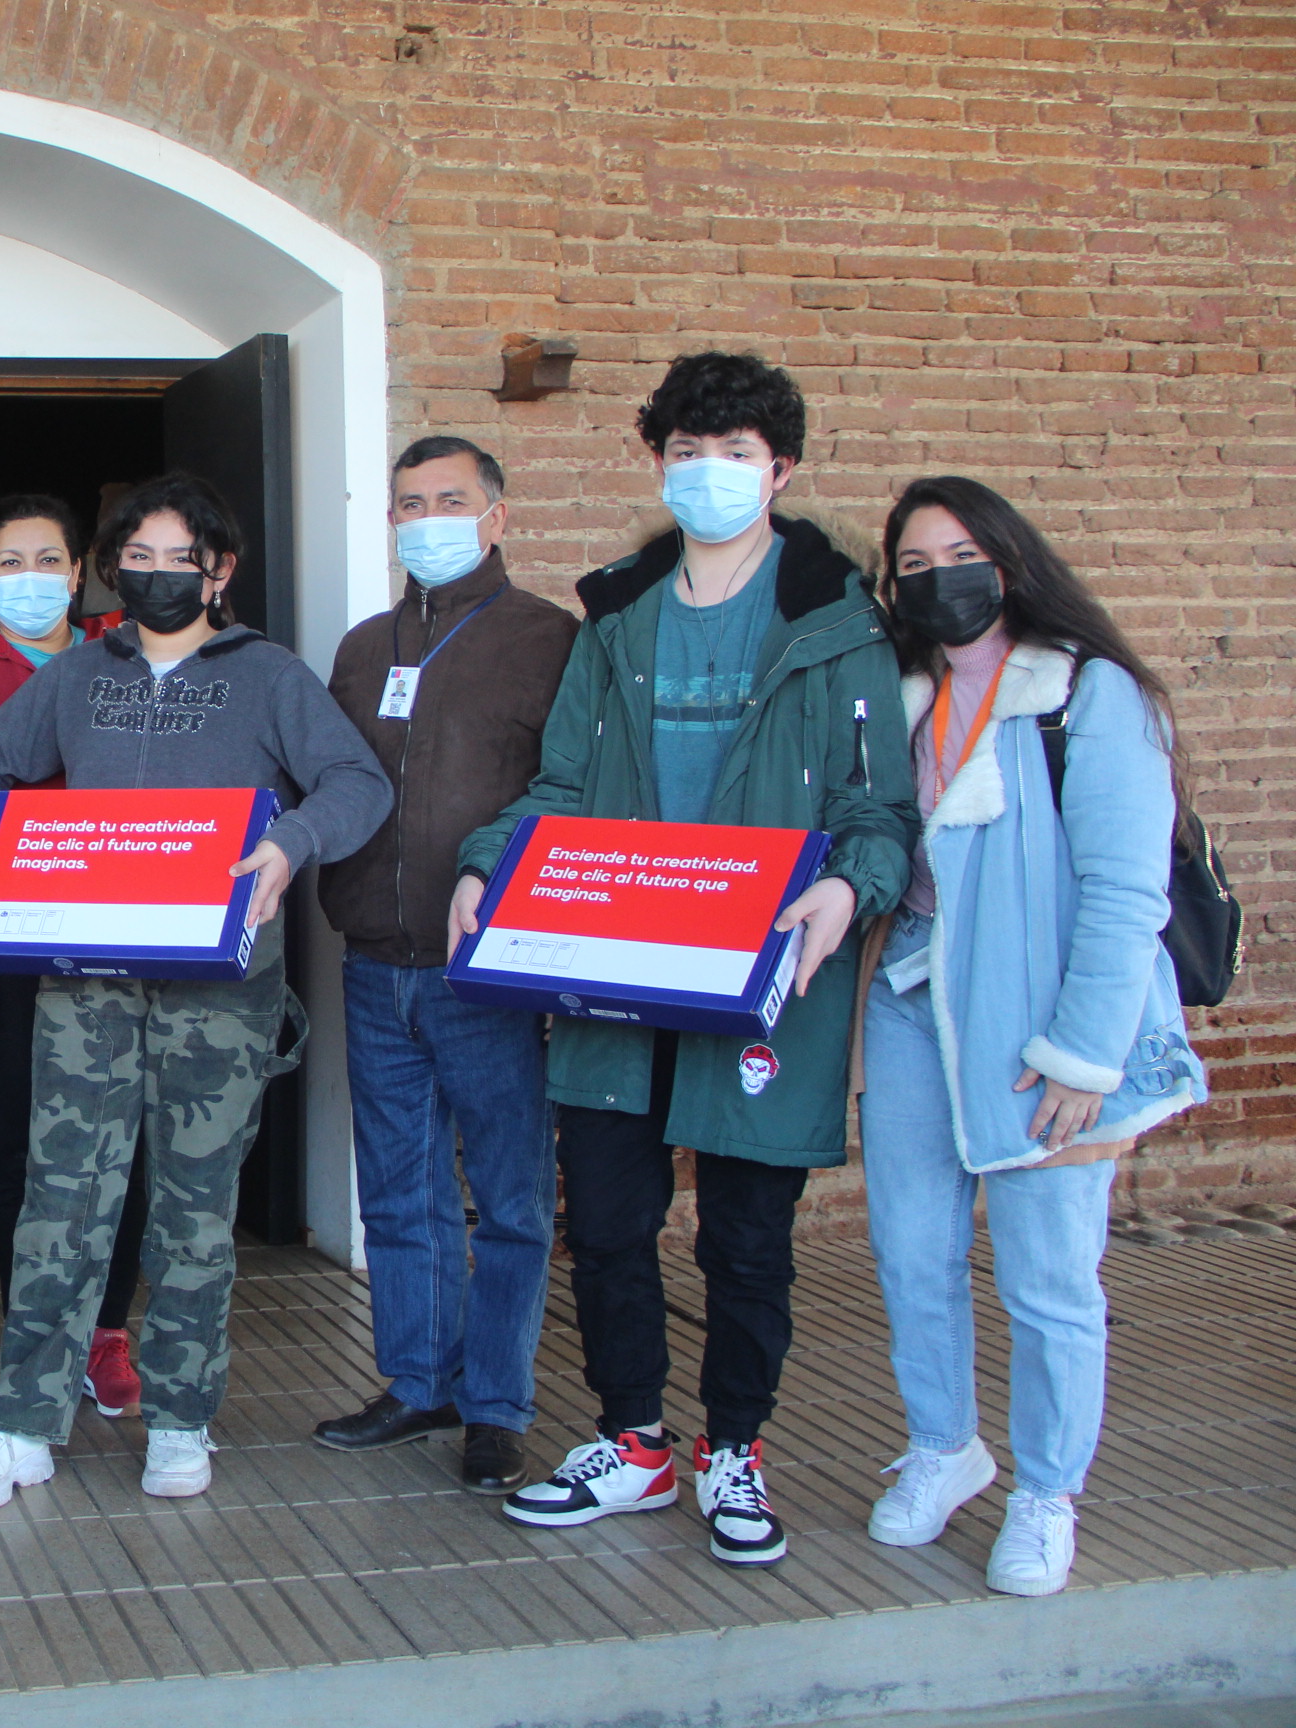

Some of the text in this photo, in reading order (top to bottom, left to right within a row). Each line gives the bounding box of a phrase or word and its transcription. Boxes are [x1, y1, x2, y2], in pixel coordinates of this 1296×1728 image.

[22, 819, 217, 833] Enciende tu creatividad.
[17, 837, 193, 854] Dale clic al futuro que
[12, 856, 88, 872] imaginas.
[548, 847, 759, 873] Enciende tu creatividad.
[539, 865, 729, 893] Dale clic al futuro que
[530, 883, 612, 902] imaginas.
